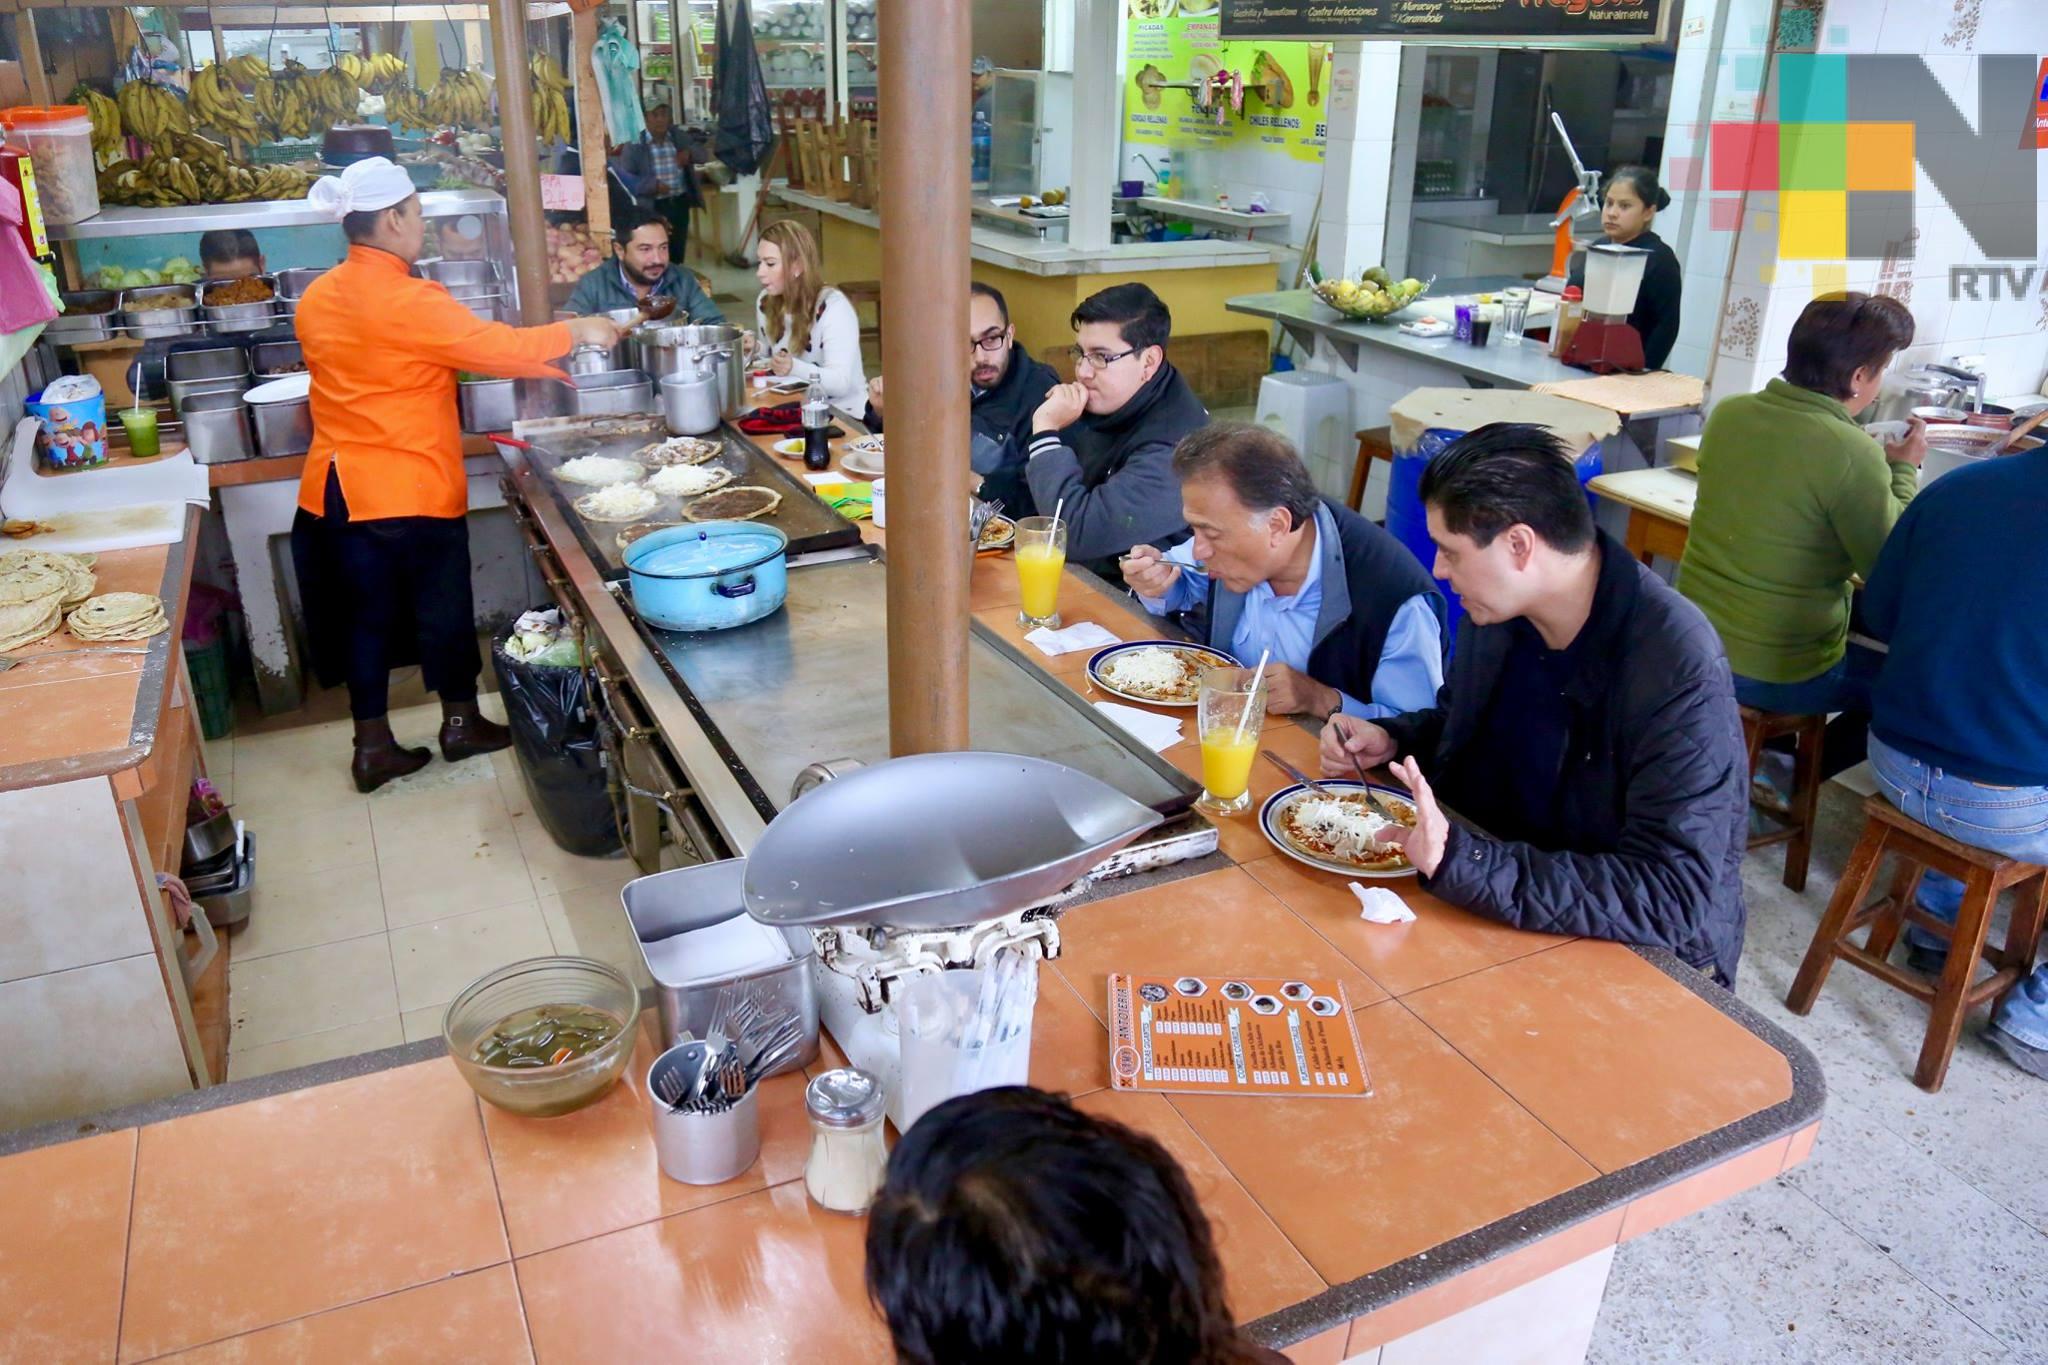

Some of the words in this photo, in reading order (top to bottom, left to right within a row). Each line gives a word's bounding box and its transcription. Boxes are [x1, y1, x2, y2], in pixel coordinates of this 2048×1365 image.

[1307, 7, 1332, 17] Contra
[1333, 6, 1379, 17] Infecciones
[1589, 10, 1649, 21] Naturalmente
[1249, 115, 1270, 127] CHILES
[1271, 116, 1300, 129] RELLENOS
